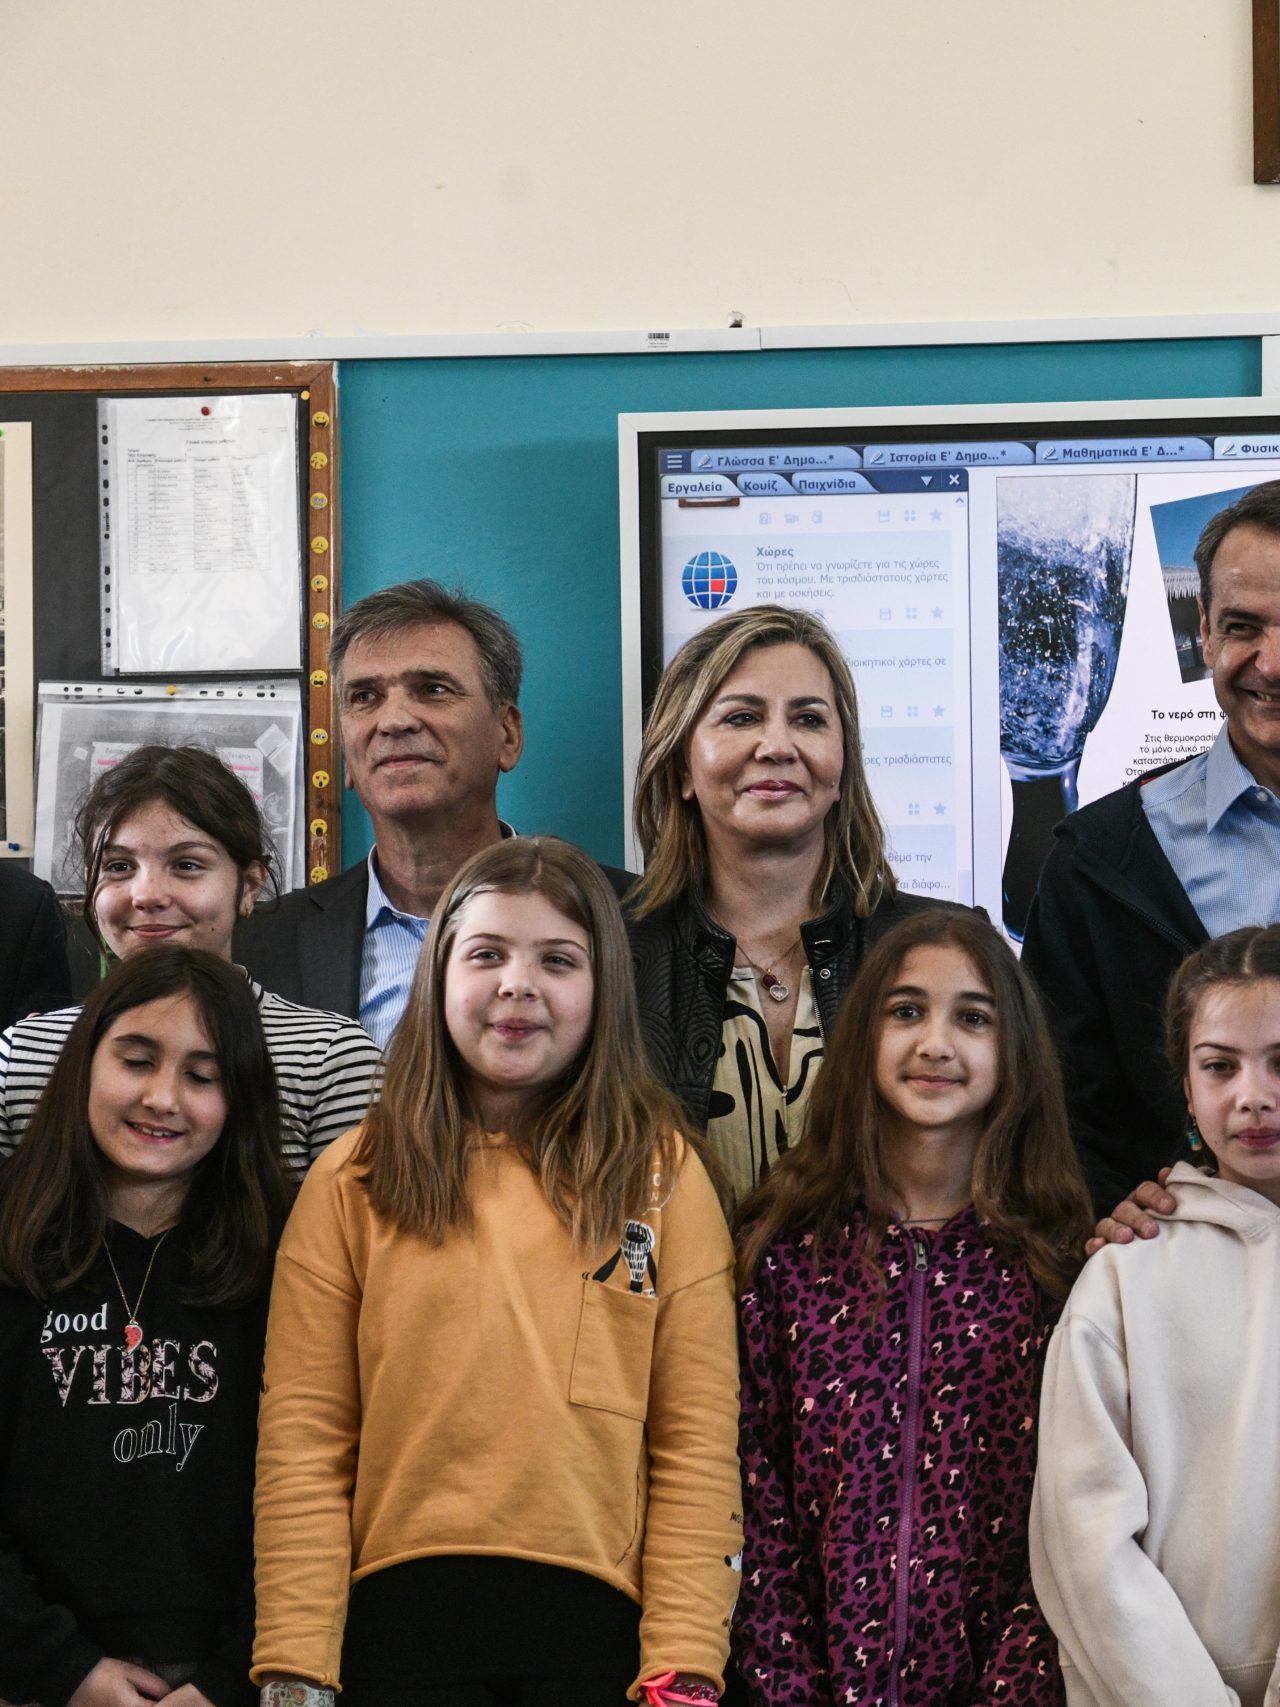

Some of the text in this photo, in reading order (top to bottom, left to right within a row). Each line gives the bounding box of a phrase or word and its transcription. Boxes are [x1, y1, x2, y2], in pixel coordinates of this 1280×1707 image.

[889, 450, 936, 465] Ιστορία
[1062, 445, 1138, 460] Μαθηματικά
[717, 455, 765, 468] Γλώσσα
[667, 481, 723, 495] Εργαλεία
[743, 480, 778, 492] Κουίζ
[799, 478, 856, 491] Παιχνίδια
[756, 546, 794, 558] Χώρες
[756, 558, 939, 572] Ότι πρέπει να γνωρίζετε για τις χώρες
[756, 576, 774, 585] του
[819, 574, 834, 584] Με
[837, 572, 911, 586] τρισδιάστατους
[914, 570, 948, 583] χάρτες
[756, 590, 771, 599] και
[774, 590, 786, 600] με
[898, 655, 932, 668] χάρτες
[934, 657, 947, 666] σε
[1151, 709, 1165, 720] Το
[1168, 708, 1194, 721] νερό
[1197, 709, 1216, 721] στη
[1144, 733, 1162, 743] Στις
[1140, 746, 1149, 754] το
[1152, 744, 1173, 755] μόνο
[1175, 743, 1198, 754] υλικό
[883, 754, 952, 767] τρισδιάστατες
[915, 854, 933, 864] την
[40, 1302, 108, 1343] good
[41, 1338, 220, 1408] VIBES
[113, 1402, 205, 1472] only
